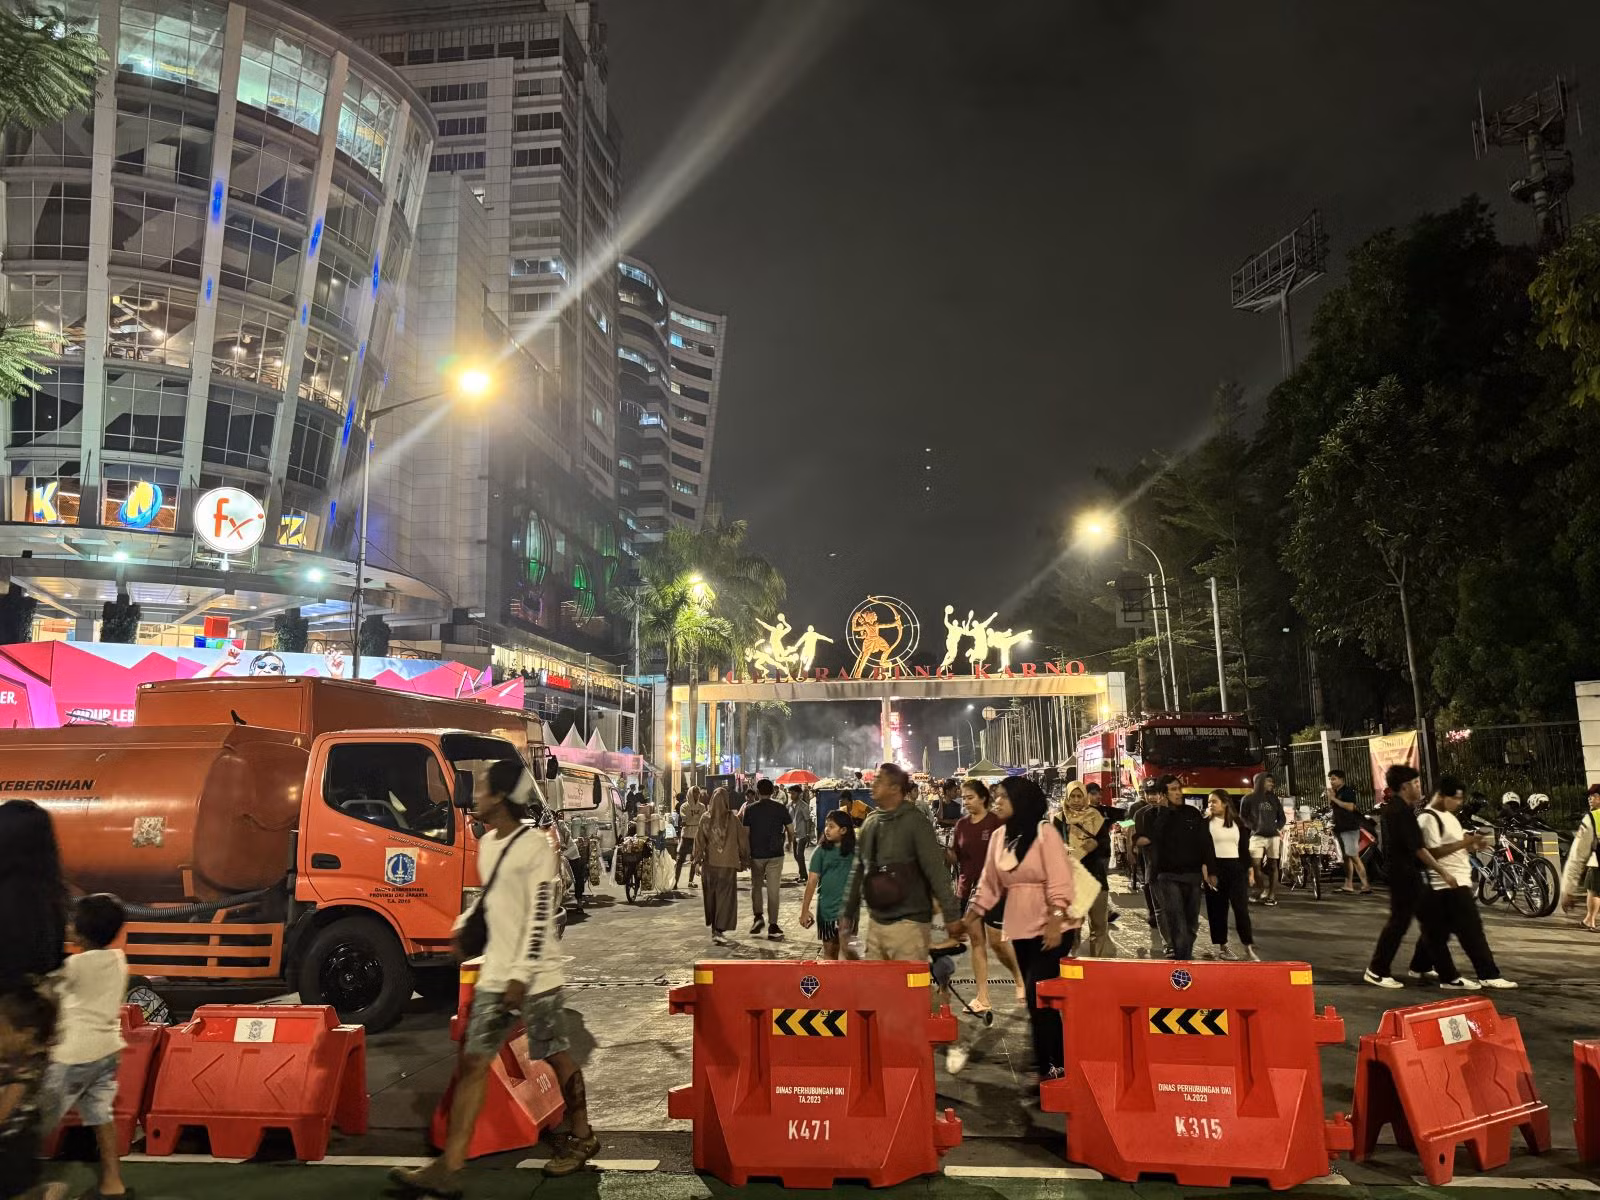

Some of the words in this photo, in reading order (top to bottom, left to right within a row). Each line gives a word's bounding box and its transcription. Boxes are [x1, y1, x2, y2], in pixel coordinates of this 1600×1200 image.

[33, 481, 58, 521] K
[974, 660, 1085, 680] KARNO
[775, 1086, 793, 1094] DINAS
[794, 1086, 834, 1095] PERHUBUNGAN
[834, 1087, 845, 1096] DKI
[1158, 1083, 1176, 1092] DINAS
[1177, 1084, 1220, 1094] PERHUBUNGAN
[1221, 1086, 1232, 1095] DKI
[788, 1119, 830, 1141] K471
[1175, 1115, 1223, 1140] K315
